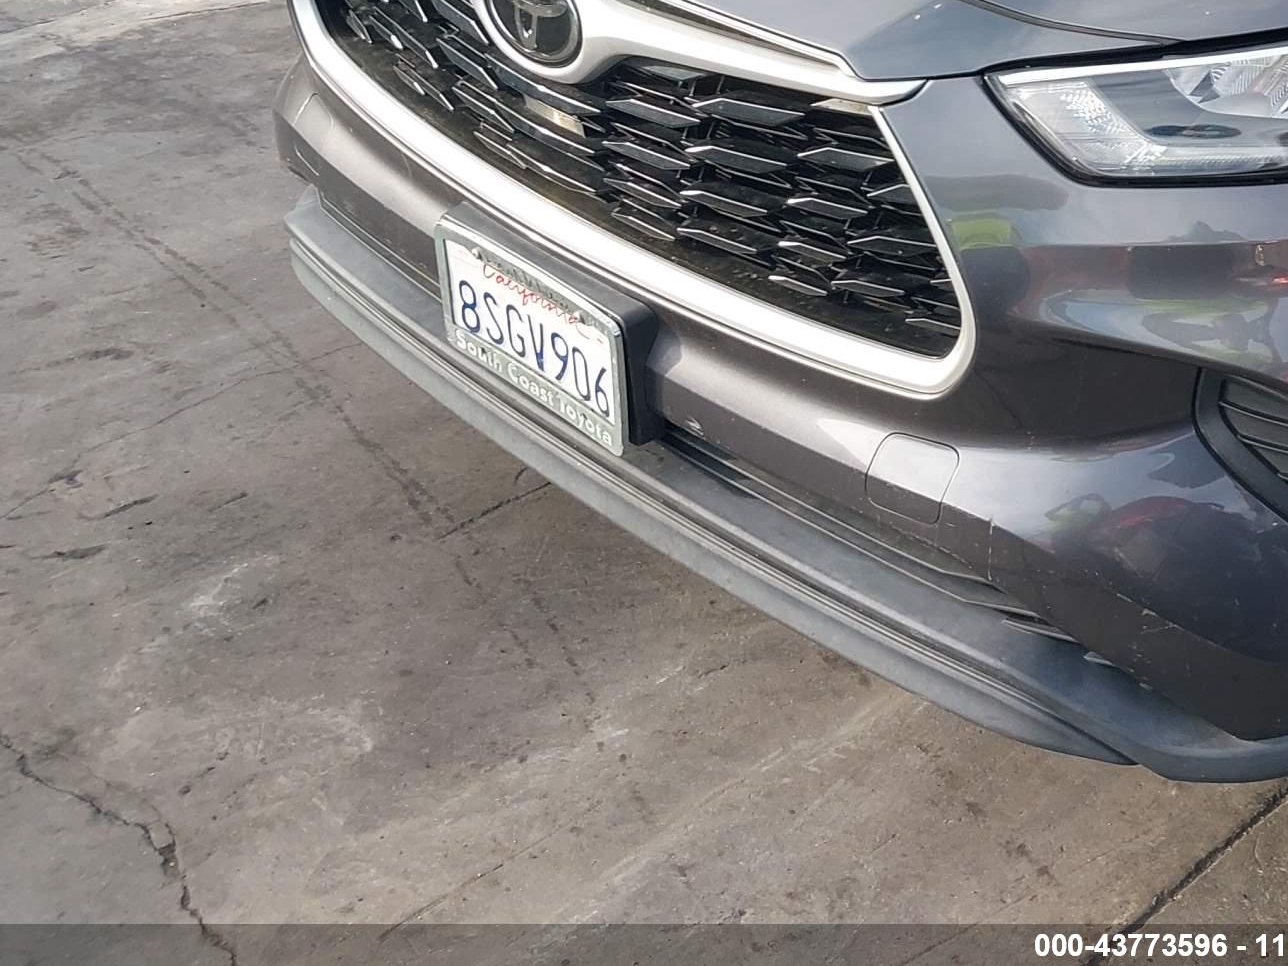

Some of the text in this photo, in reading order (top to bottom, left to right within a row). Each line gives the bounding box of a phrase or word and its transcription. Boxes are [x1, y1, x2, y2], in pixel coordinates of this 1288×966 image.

[454, 329, 613, 447] South Coast Toyota
[459, 280, 610, 418] 8SGV906
